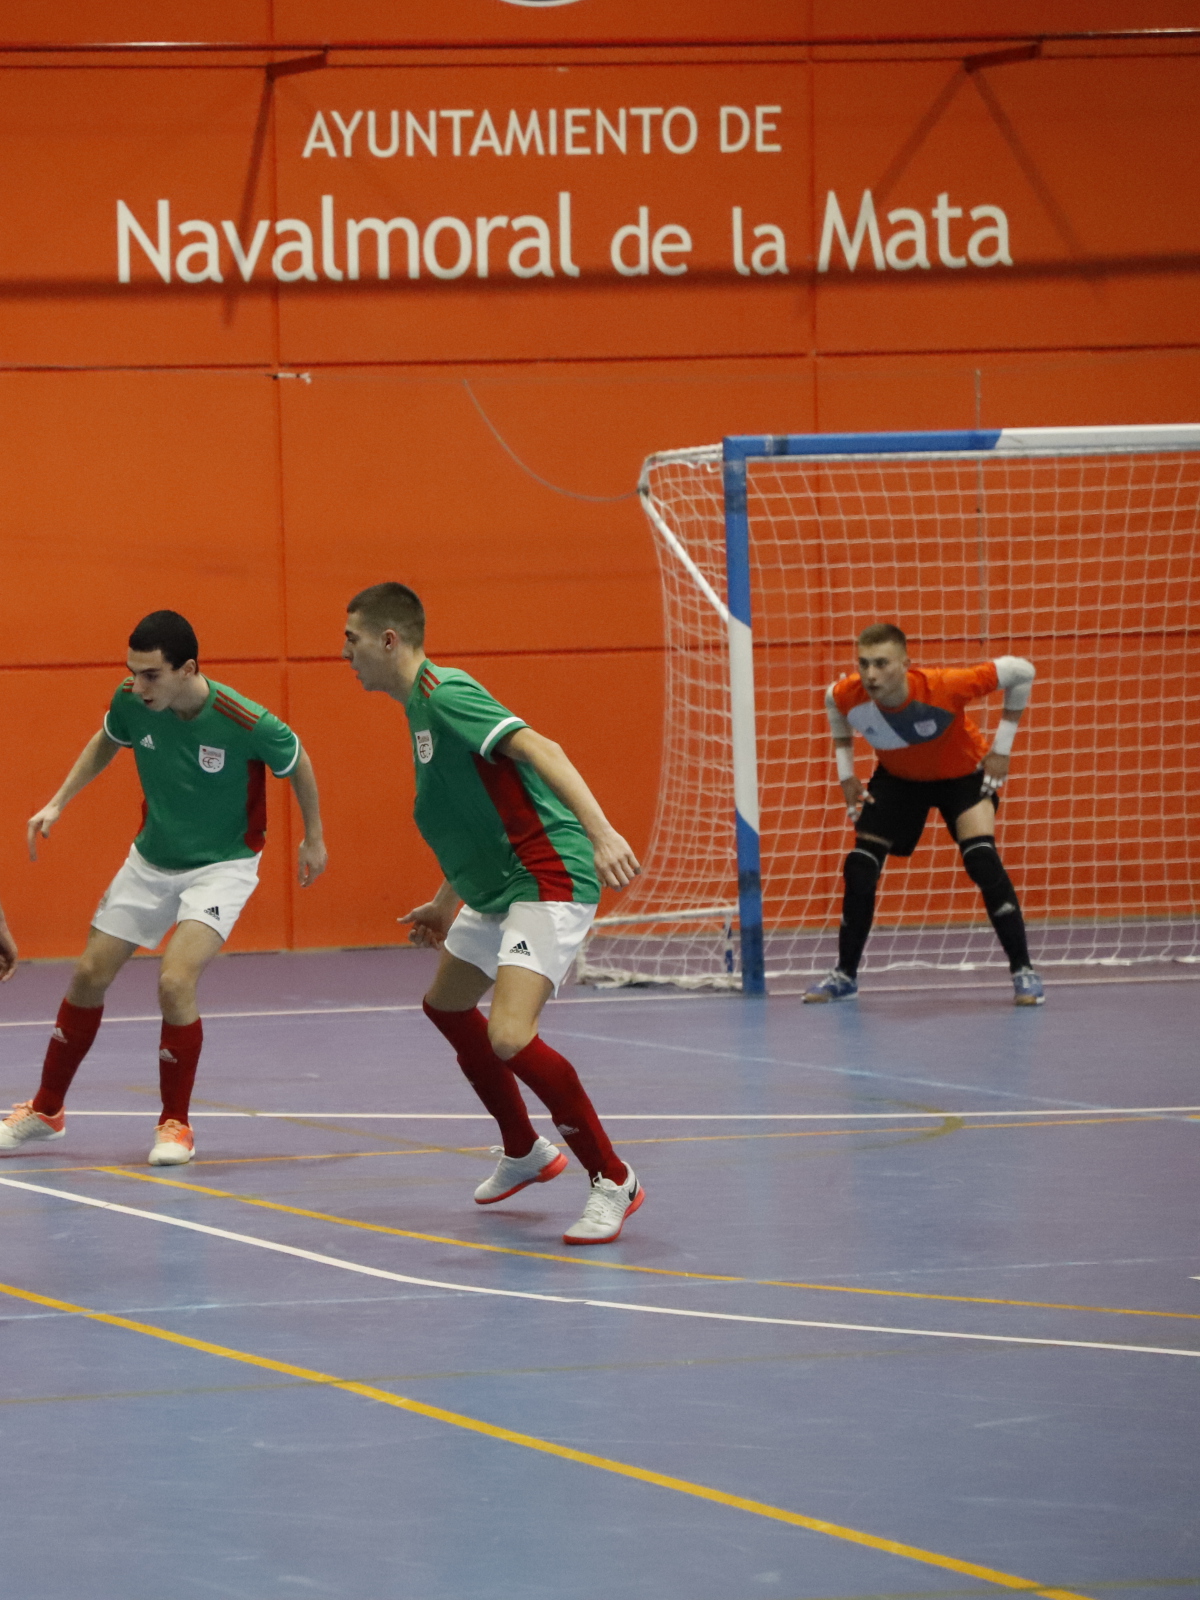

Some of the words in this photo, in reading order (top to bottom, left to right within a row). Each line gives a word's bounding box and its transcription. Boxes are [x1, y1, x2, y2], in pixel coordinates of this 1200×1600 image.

[301, 106, 699, 159] AYUNTAMIENTO
[718, 105, 783, 154] DE
[116, 191, 580, 284] Navalmoral
[610, 205, 693, 277] de
[732, 206, 789, 276] la
[818, 189, 1014, 272] Mata
